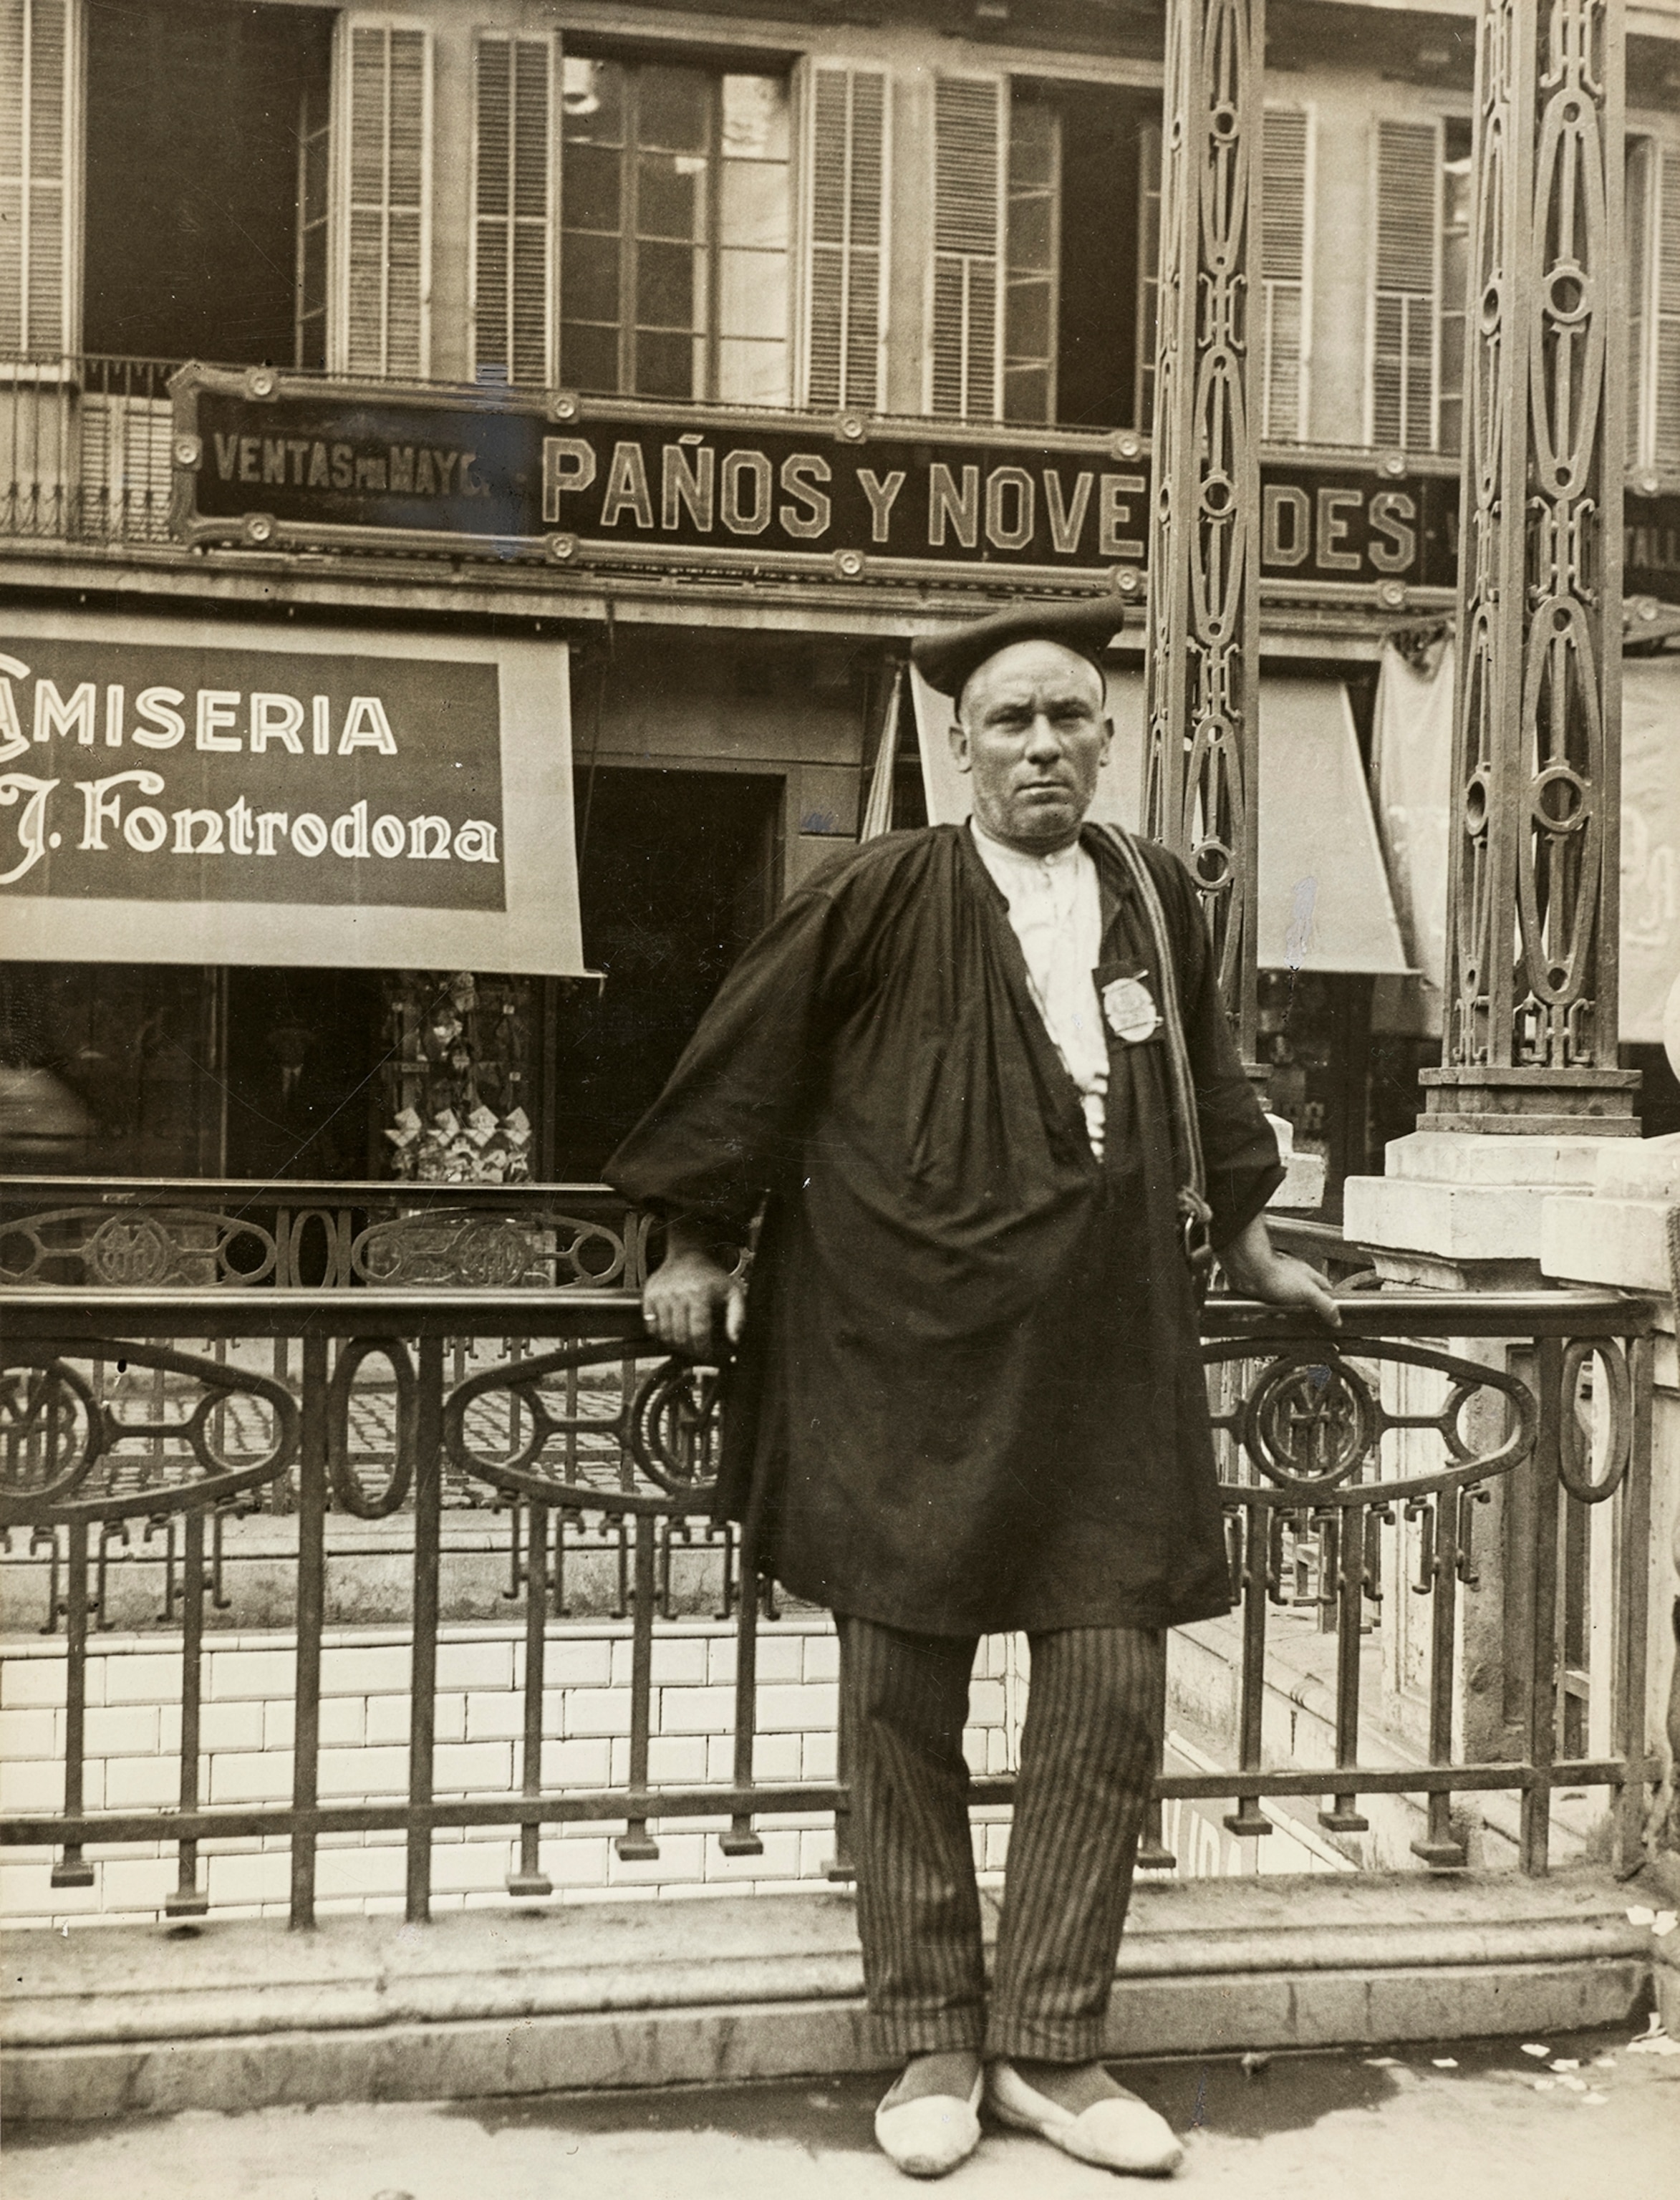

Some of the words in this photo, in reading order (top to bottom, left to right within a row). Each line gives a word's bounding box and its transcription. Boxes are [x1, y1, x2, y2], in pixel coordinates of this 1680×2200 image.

[212, 432, 353, 489] VENTAS
[542, 434, 832, 539] PAÑOS
[857, 469, 907, 542] Y
[74, 770, 501, 863] Fontrodona
